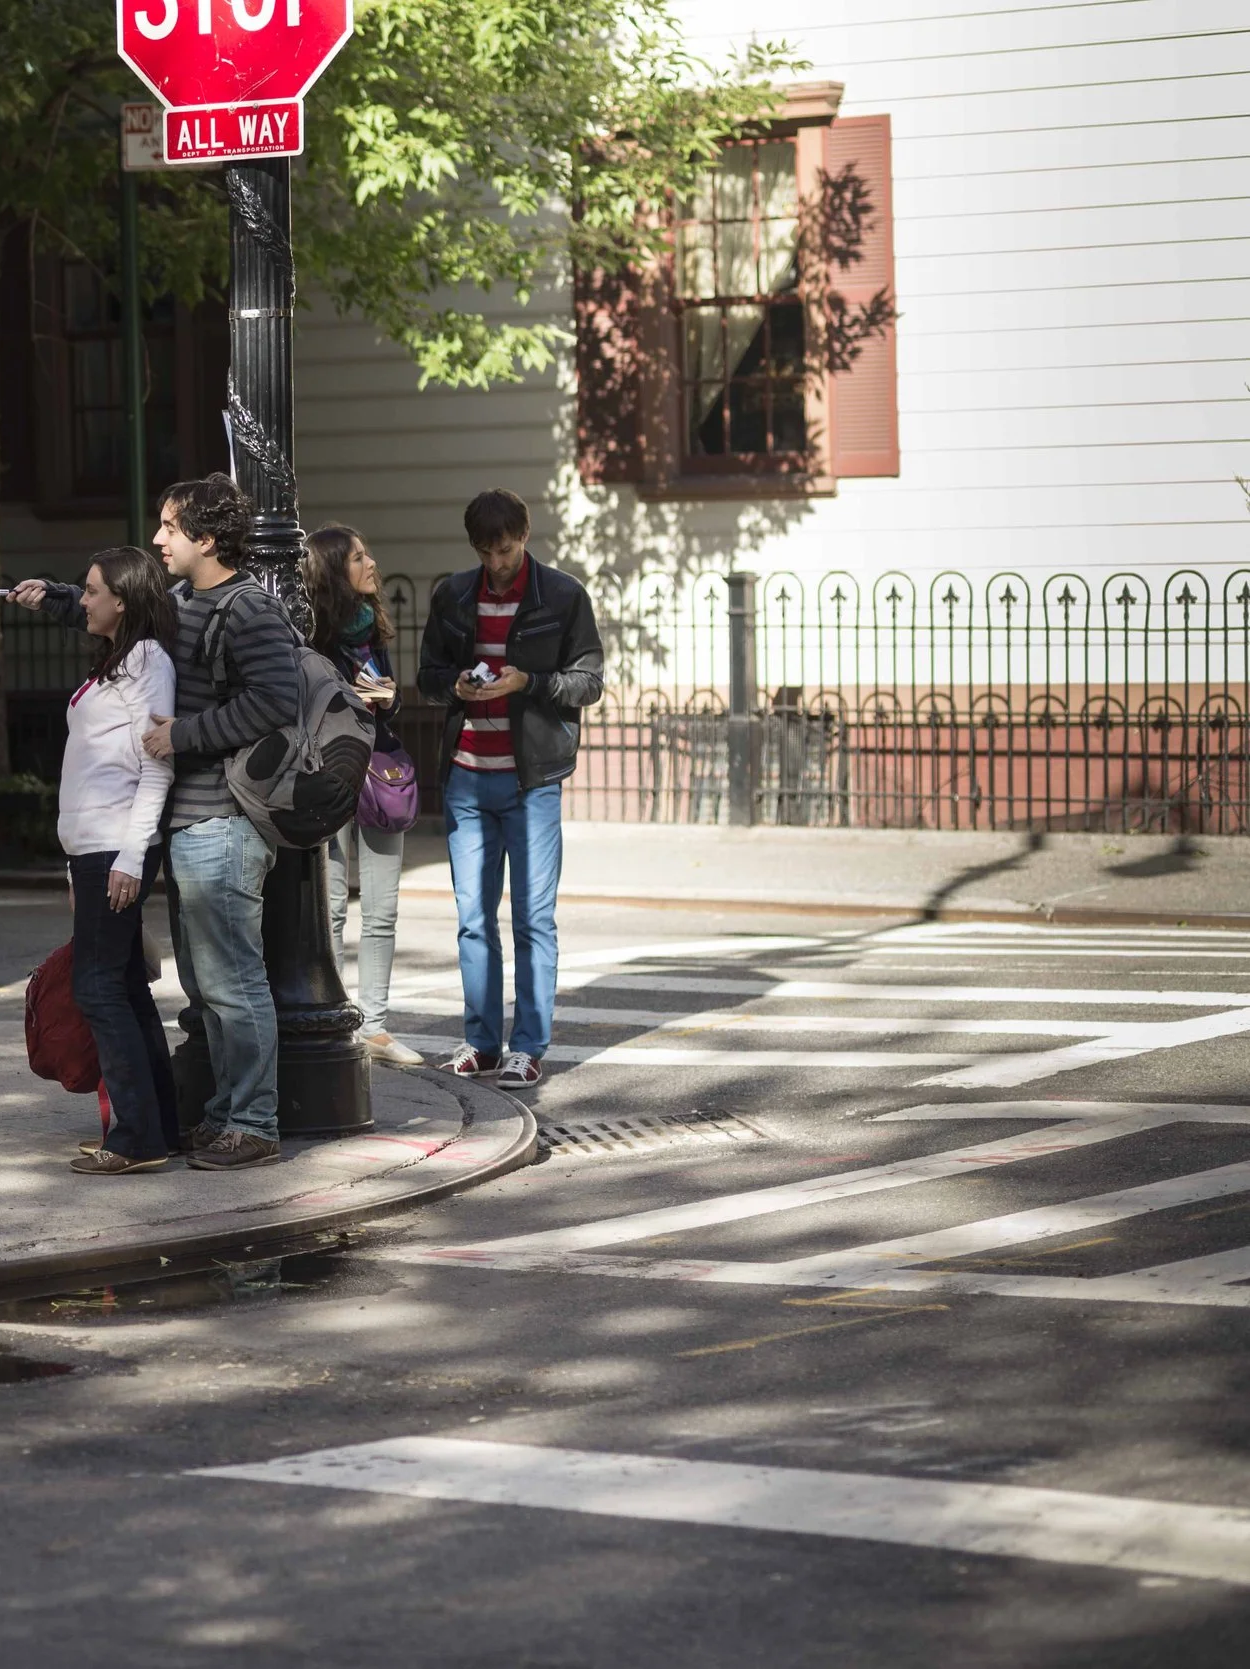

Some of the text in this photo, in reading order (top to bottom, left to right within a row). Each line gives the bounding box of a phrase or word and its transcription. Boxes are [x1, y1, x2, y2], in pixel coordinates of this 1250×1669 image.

[127, 108, 152, 130] NO
[177, 117, 224, 151] ALL
[238, 111, 290, 146] WAY
[223, 144, 285, 155] TRANSPORTATION
